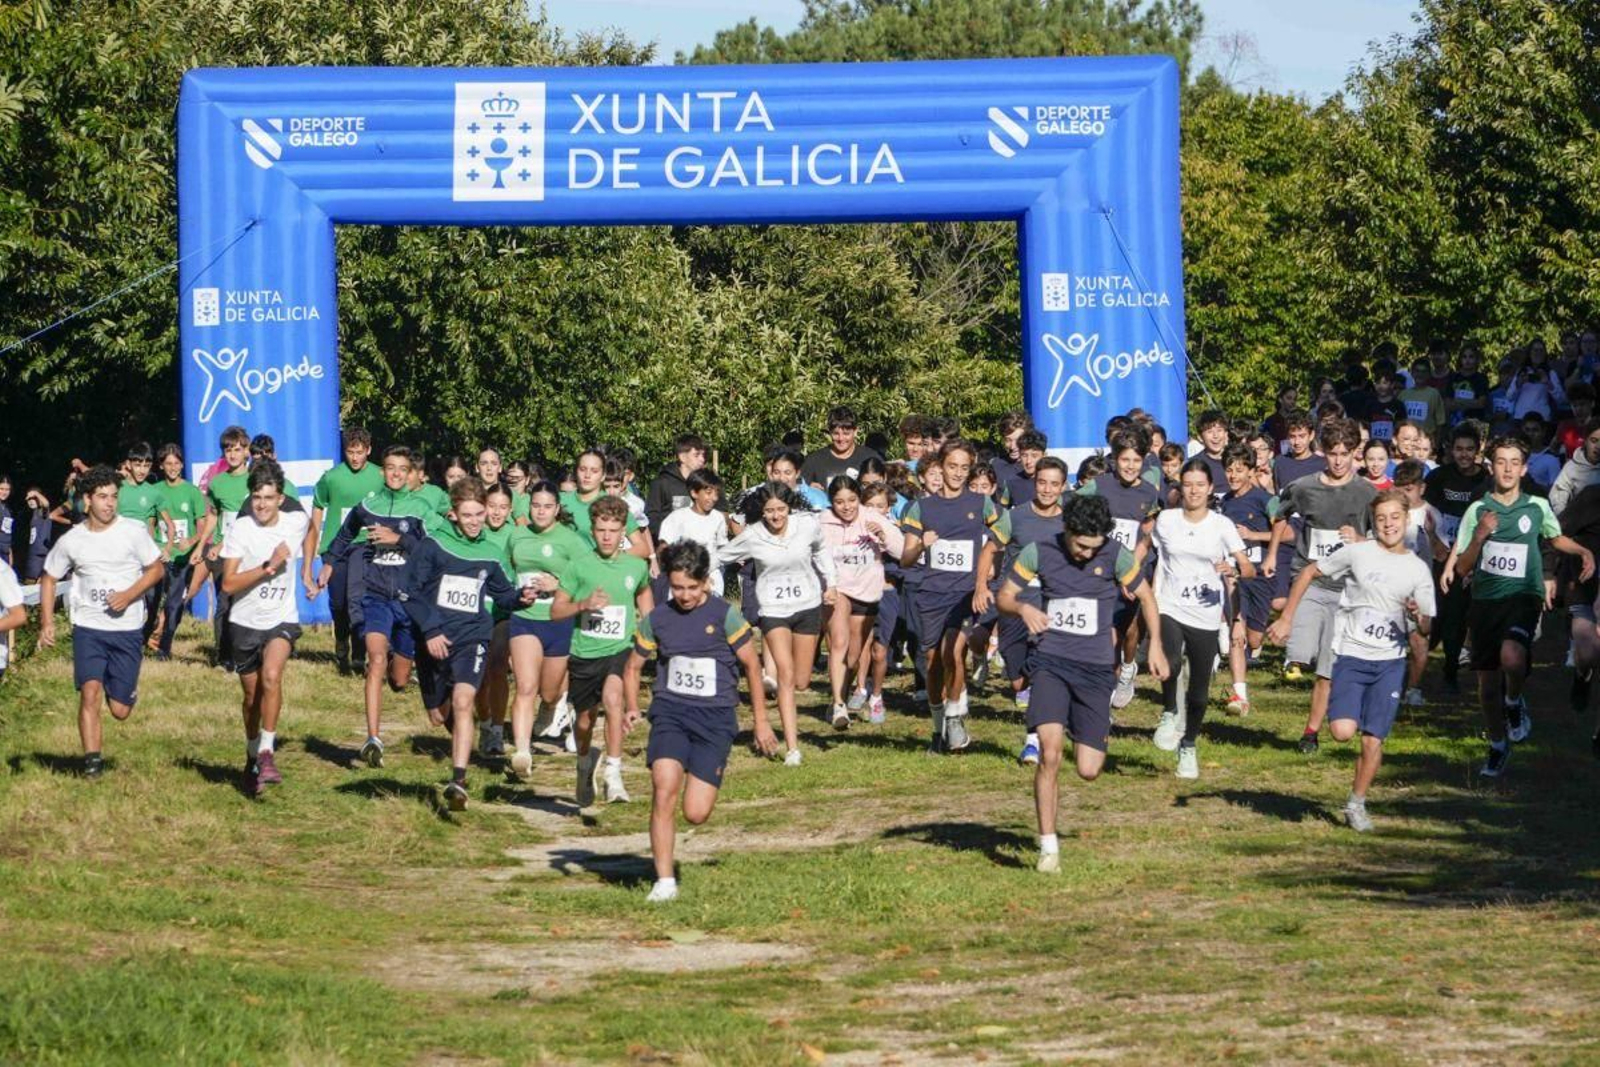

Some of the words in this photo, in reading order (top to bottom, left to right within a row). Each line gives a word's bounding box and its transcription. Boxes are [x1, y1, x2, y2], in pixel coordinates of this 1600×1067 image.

[570, 91, 774, 135] XUNTA
[1036, 105, 1111, 120] DEPORTE
[289, 117, 366, 132] DEPORTE
[1036, 120, 1105, 136] GALEGO
[289, 132, 358, 147] GALEGO
[568, 148, 641, 189] DE
[664, 143, 905, 188] GALICIA
[1075, 276, 1133, 290] XUNTA
[225, 290, 282, 305] XUNTA
[1075, 293, 1097, 308] DE
[1102, 292, 1170, 308] GALICIA
[225, 308, 246, 322] DE
[252, 306, 320, 321] GALICIA
[937, 552, 964, 566] 358
[1488, 555, 1517, 571] 409
[260, 586, 286, 600] 877
[446, 590, 477, 608] 1030
[775, 585, 802, 599] 216
[587, 619, 621, 634] 1032
[1055, 611, 1086, 628] 345
[675, 671, 705, 690] 335
